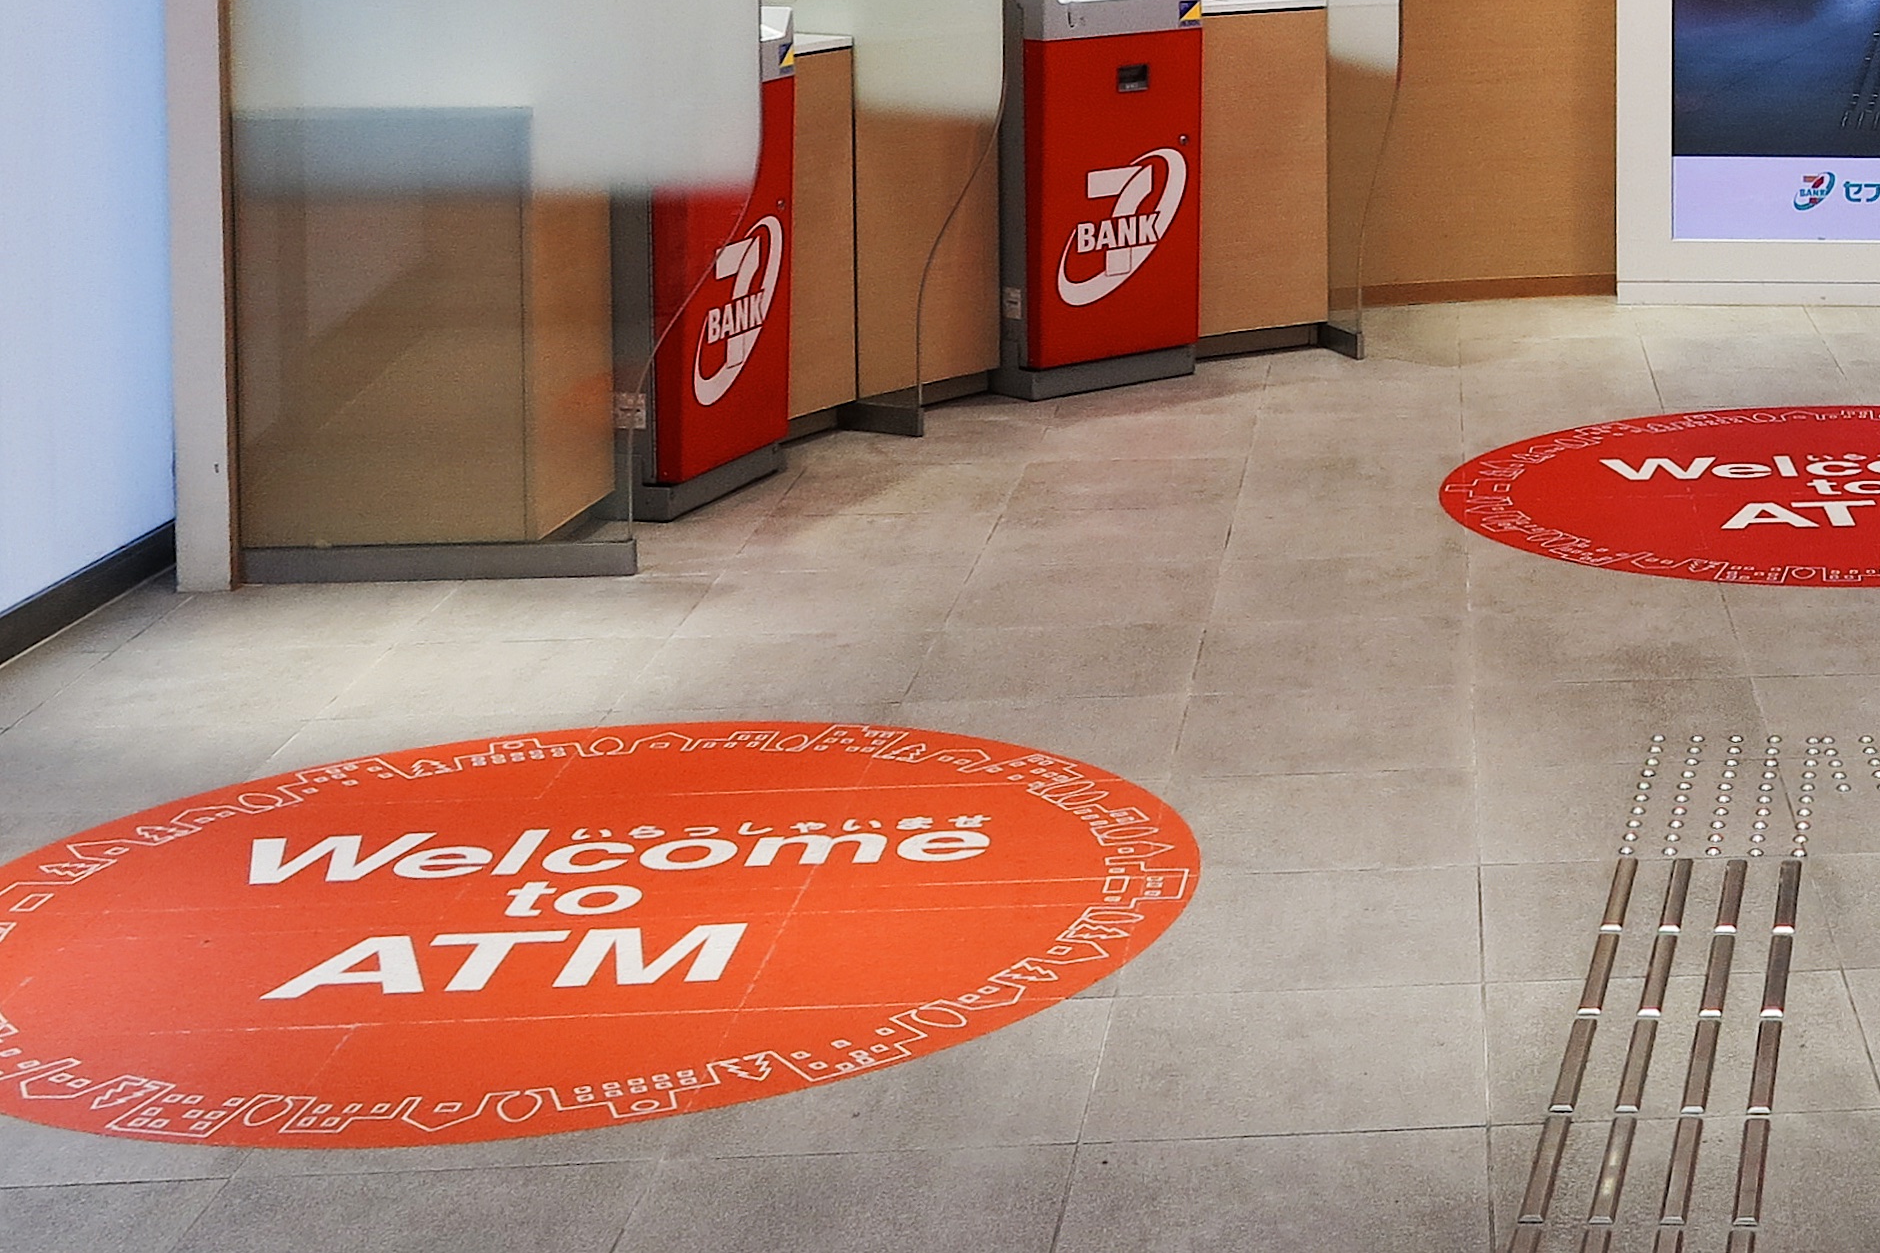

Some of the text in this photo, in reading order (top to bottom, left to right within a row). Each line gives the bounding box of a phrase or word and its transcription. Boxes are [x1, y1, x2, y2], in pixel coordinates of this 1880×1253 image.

[1077, 211, 1161, 254] BANK
[707, 287, 766, 345] BANK
[573, 813, 993, 841] いらっしゃいませ
[249, 827, 993, 886] Welcome
[503, 878, 642, 920] to
[260, 923, 748, 1001] ATM
